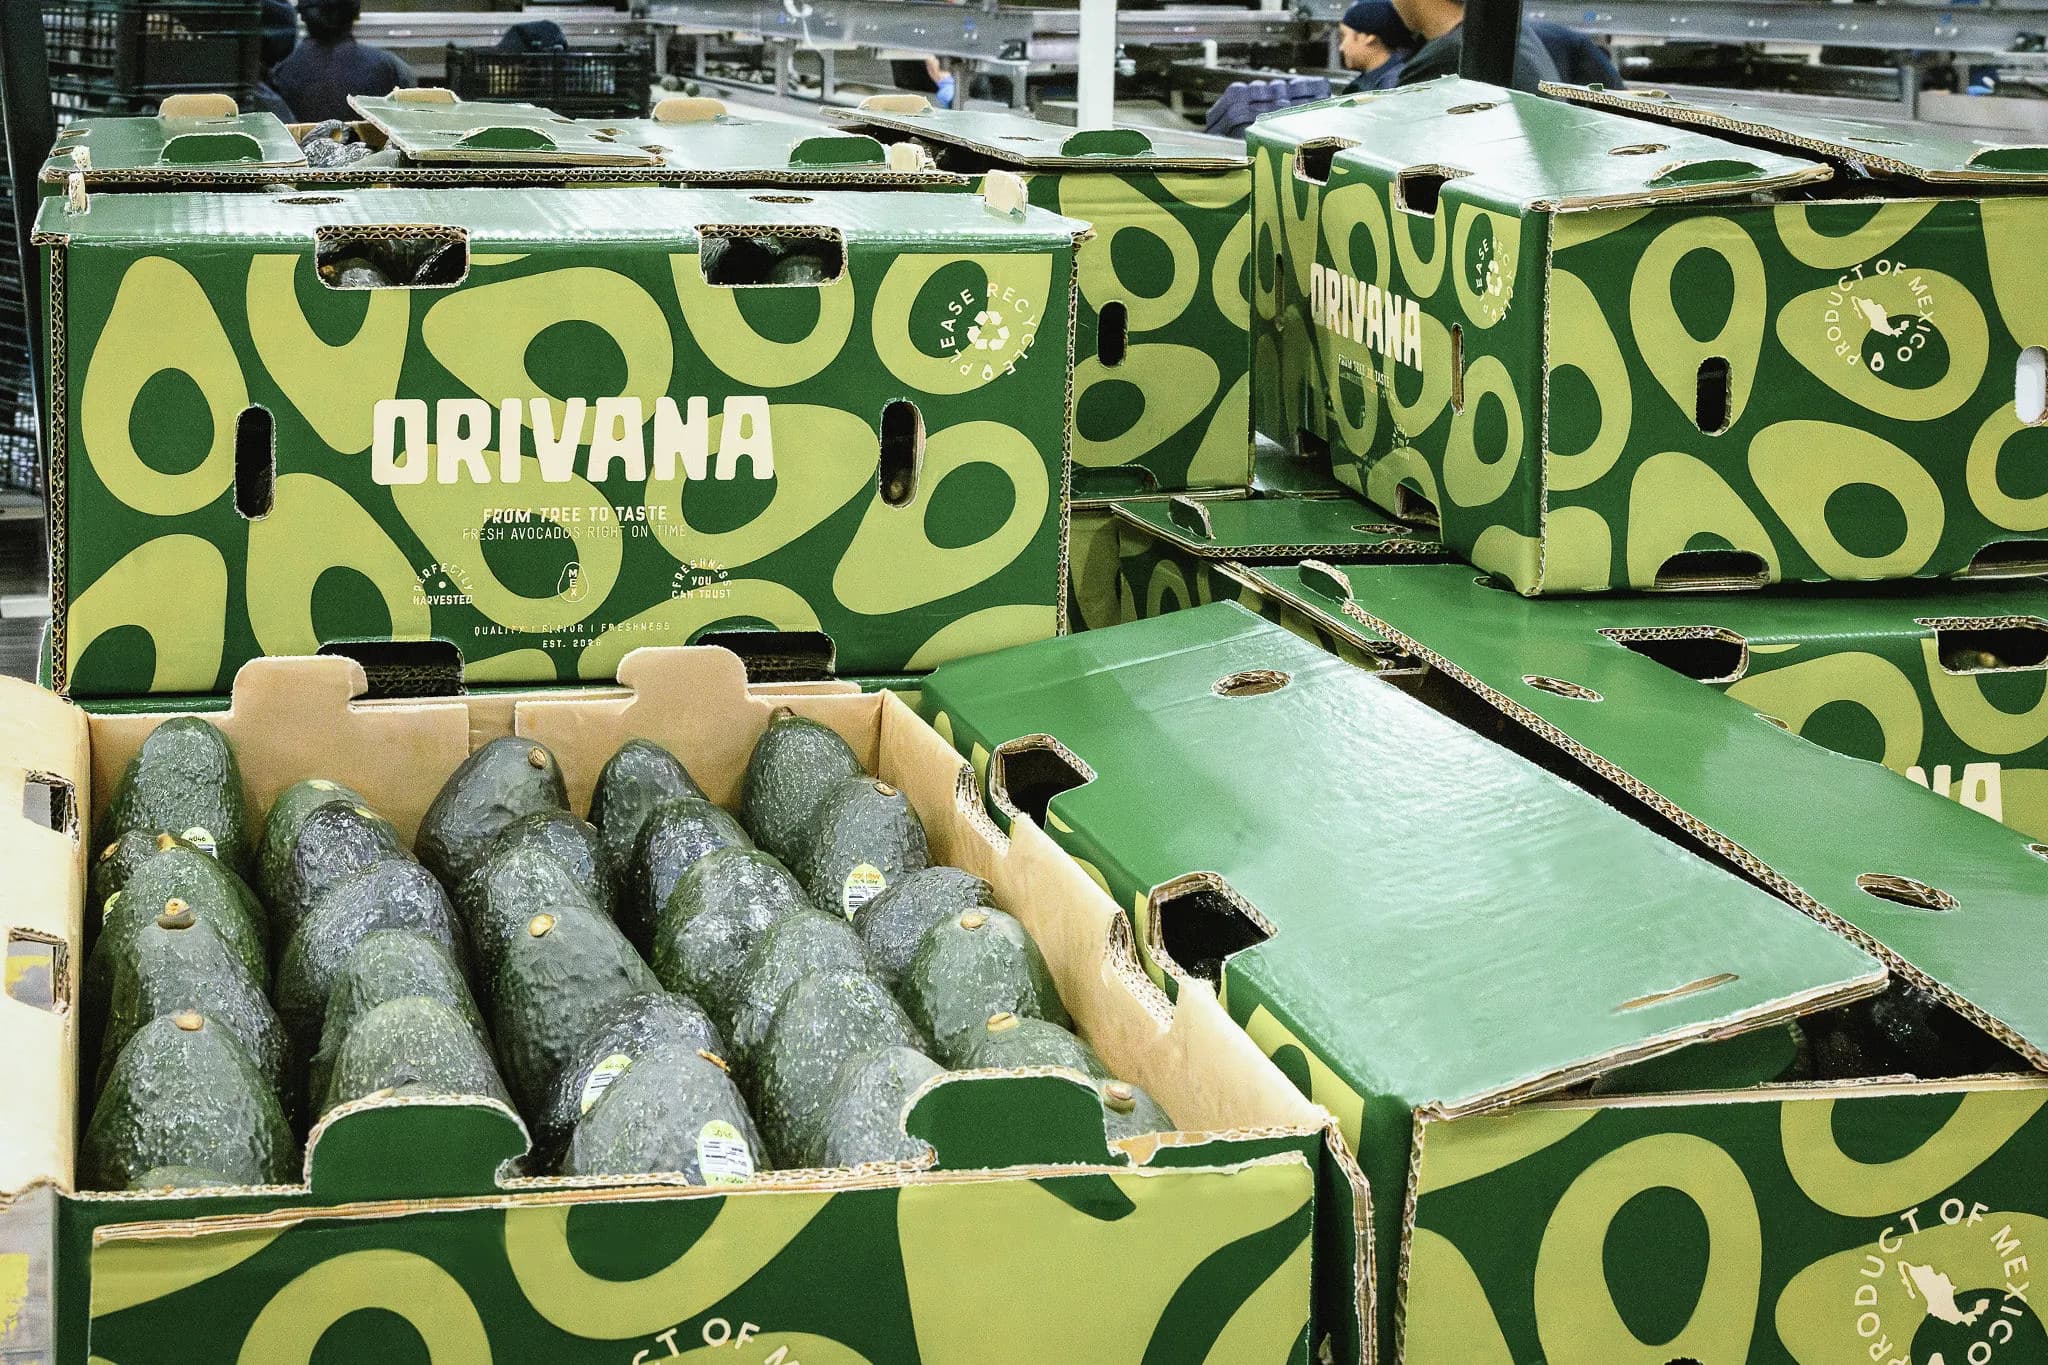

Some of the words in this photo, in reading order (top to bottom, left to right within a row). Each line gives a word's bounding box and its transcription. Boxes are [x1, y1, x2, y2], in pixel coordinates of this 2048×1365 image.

[1310, 263, 1422, 372] ORIVANA
[1825, 264, 1864, 365] PRODUCT
[1876, 259, 1906, 277] OF
[1897, 276, 1934, 362] MEXICO
[940, 289, 974, 376] PLEASE
[987, 284, 1036, 375] RECYCLE
[371, 396, 775, 485] ORIVANA
[484, 508, 531, 523] FROM
[540, 507, 580, 522] TREE
[590, 507, 609, 521] TO
[616, 505, 667, 521] TASTE
[463, 527, 504, 540] FRESH
[511, 526, 580, 540] AVOCADOS
[588, 525, 624, 538] RIGHT
[632, 525, 647, 538] ON
[657, 524, 686, 536] TIME
[414, 563, 474, 592] PERFECTLY
[672, 559, 731, 588] FRESHNESS
[692, 576, 712, 585] YOU
[414, 595, 472, 605] HARVESTED
[672, 590, 693, 599] CAN
[699, 589, 731, 598] TRUST
[602, 623, 670, 632] FRESHNESS
[543, 640, 566, 648] EST.
[1940, 1198, 1988, 1227] OF
[1968, 1225, 2029, 1365] MEXICO
[703, 1318, 760, 1349] OF
